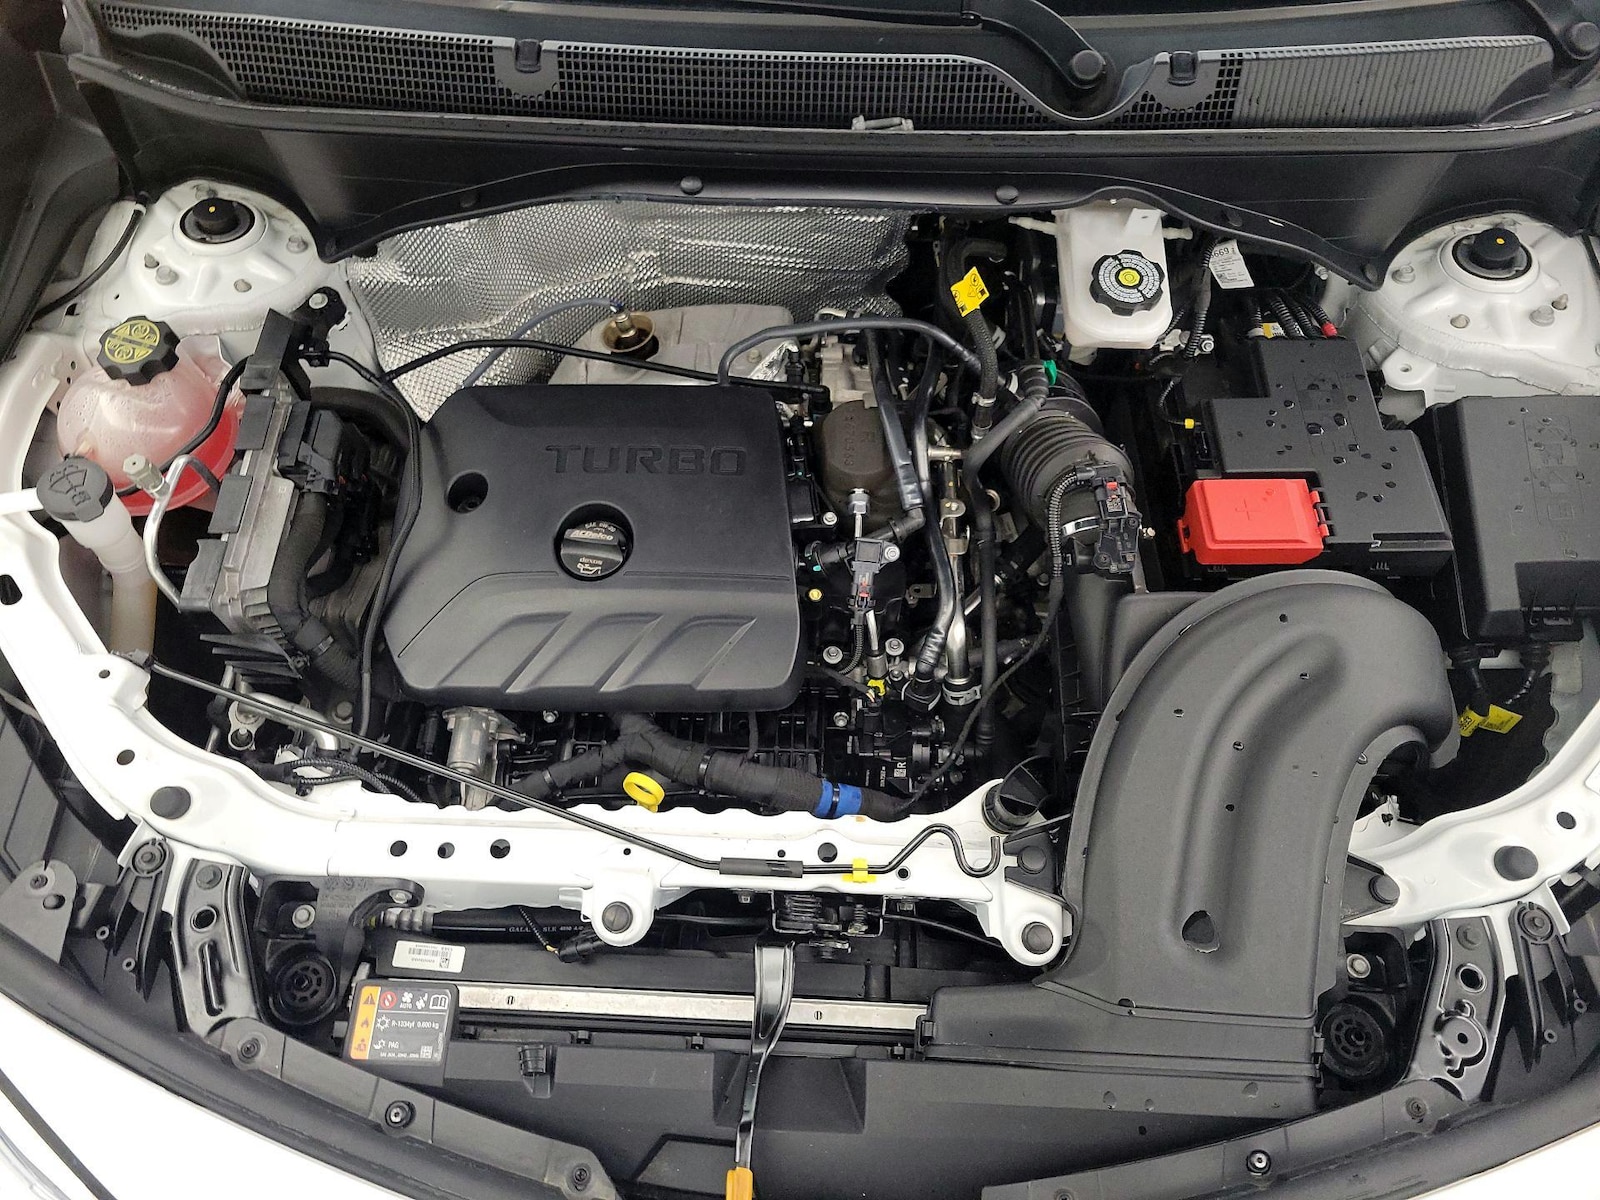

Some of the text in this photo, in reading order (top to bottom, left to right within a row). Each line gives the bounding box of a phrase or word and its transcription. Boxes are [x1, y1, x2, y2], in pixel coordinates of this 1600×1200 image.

[545, 445, 747, 476] TURBO
[570, 530, 614, 541] ACDelco
[579, 557, 603, 565] dexos
[388, 1041, 400, 1049] PAG
